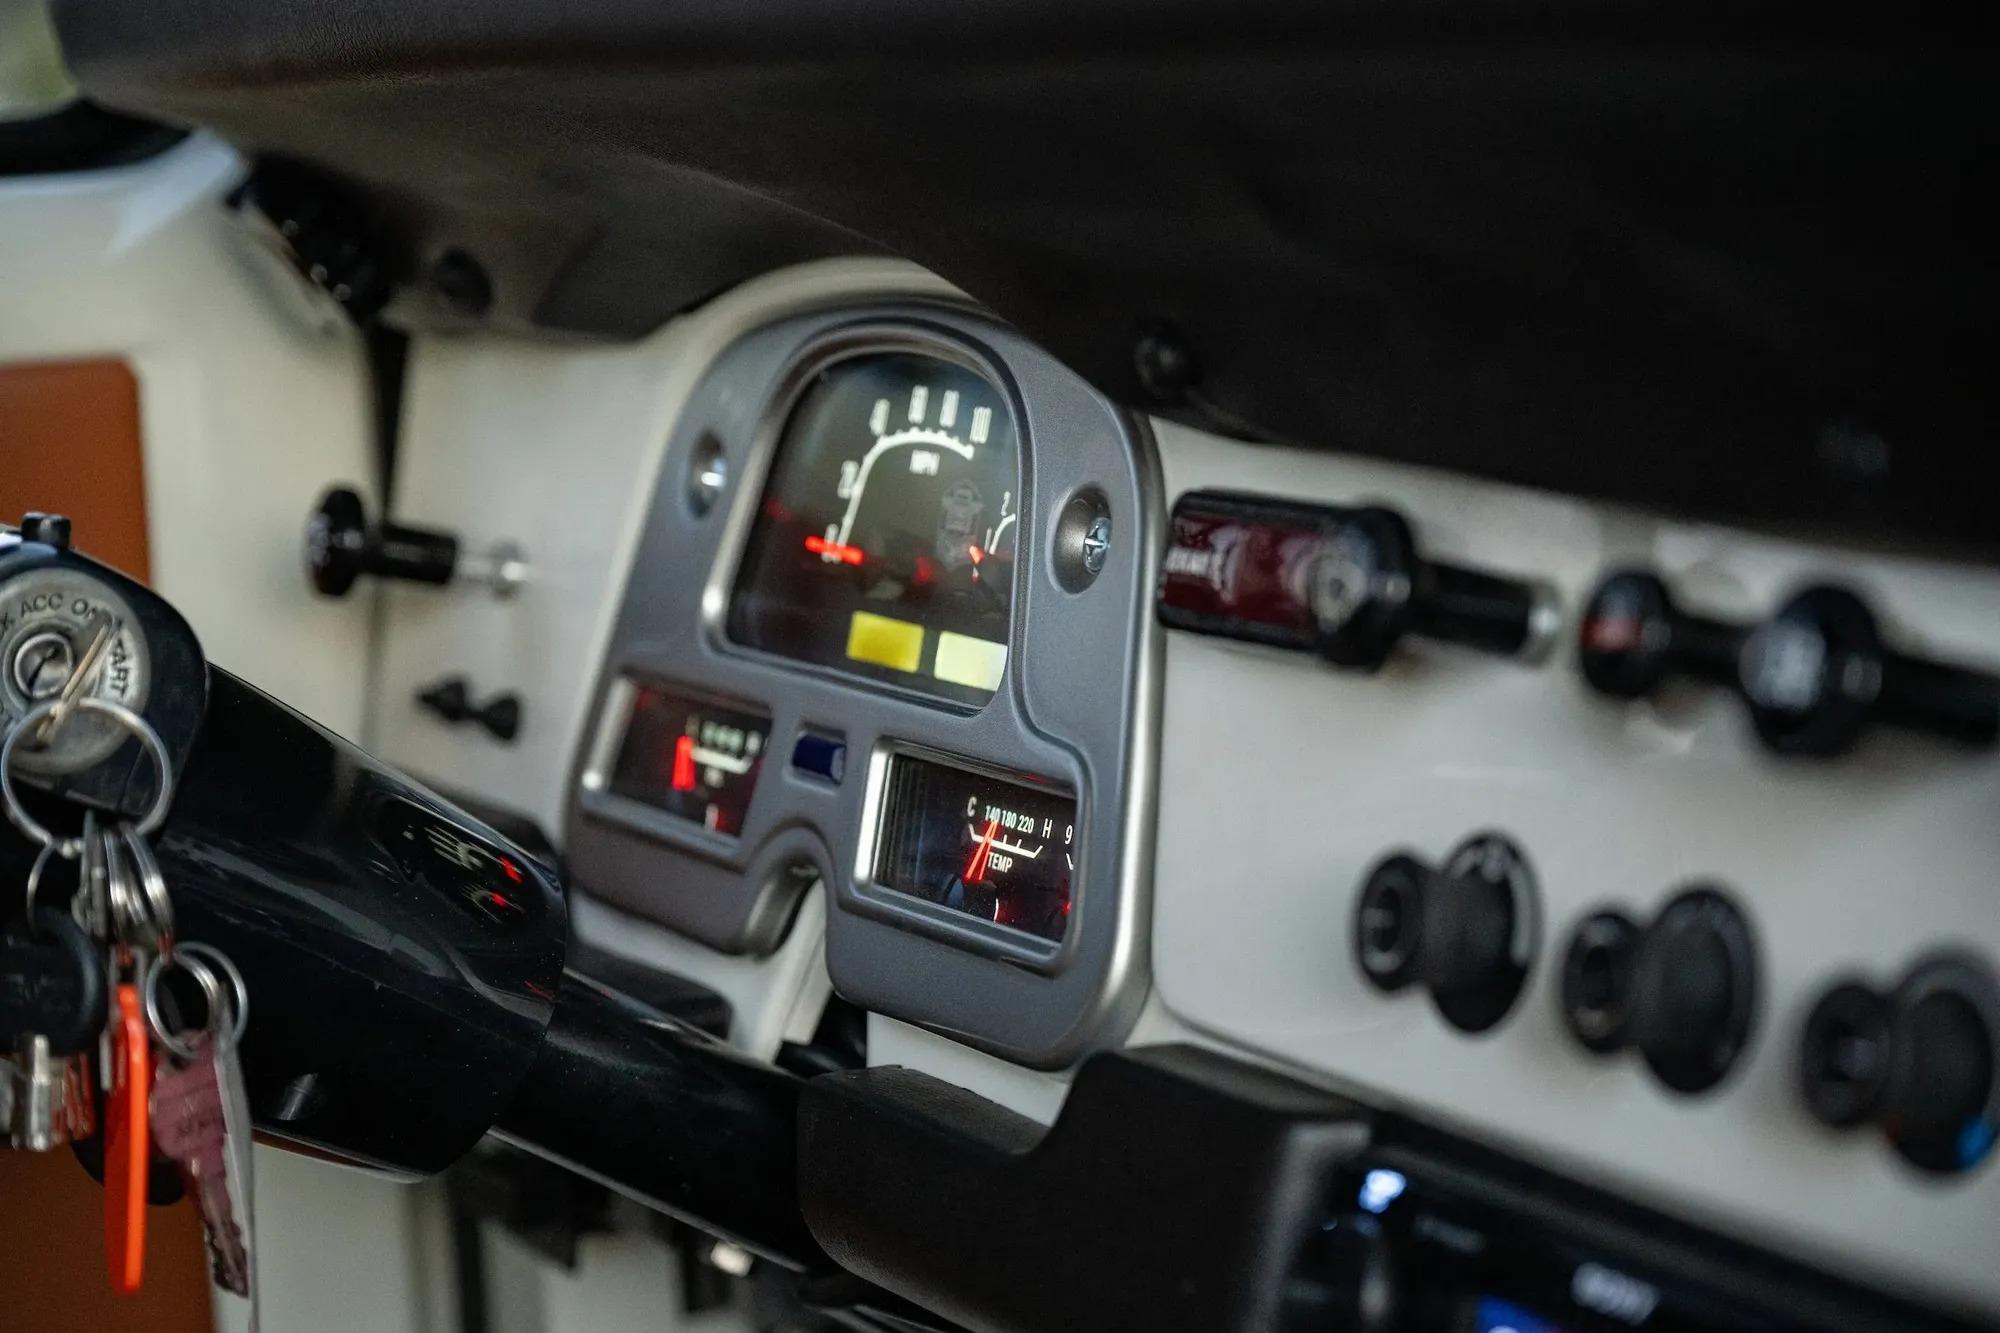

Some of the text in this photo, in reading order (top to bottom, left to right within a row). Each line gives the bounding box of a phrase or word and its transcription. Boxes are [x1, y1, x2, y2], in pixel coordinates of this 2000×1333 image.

[20, 592, 63, 617] ACC
[967, 796, 1053, 839] C 140 180 220 H
[1065, 825, 1073, 844] 9
[987, 852, 1013, 873] TEMP
